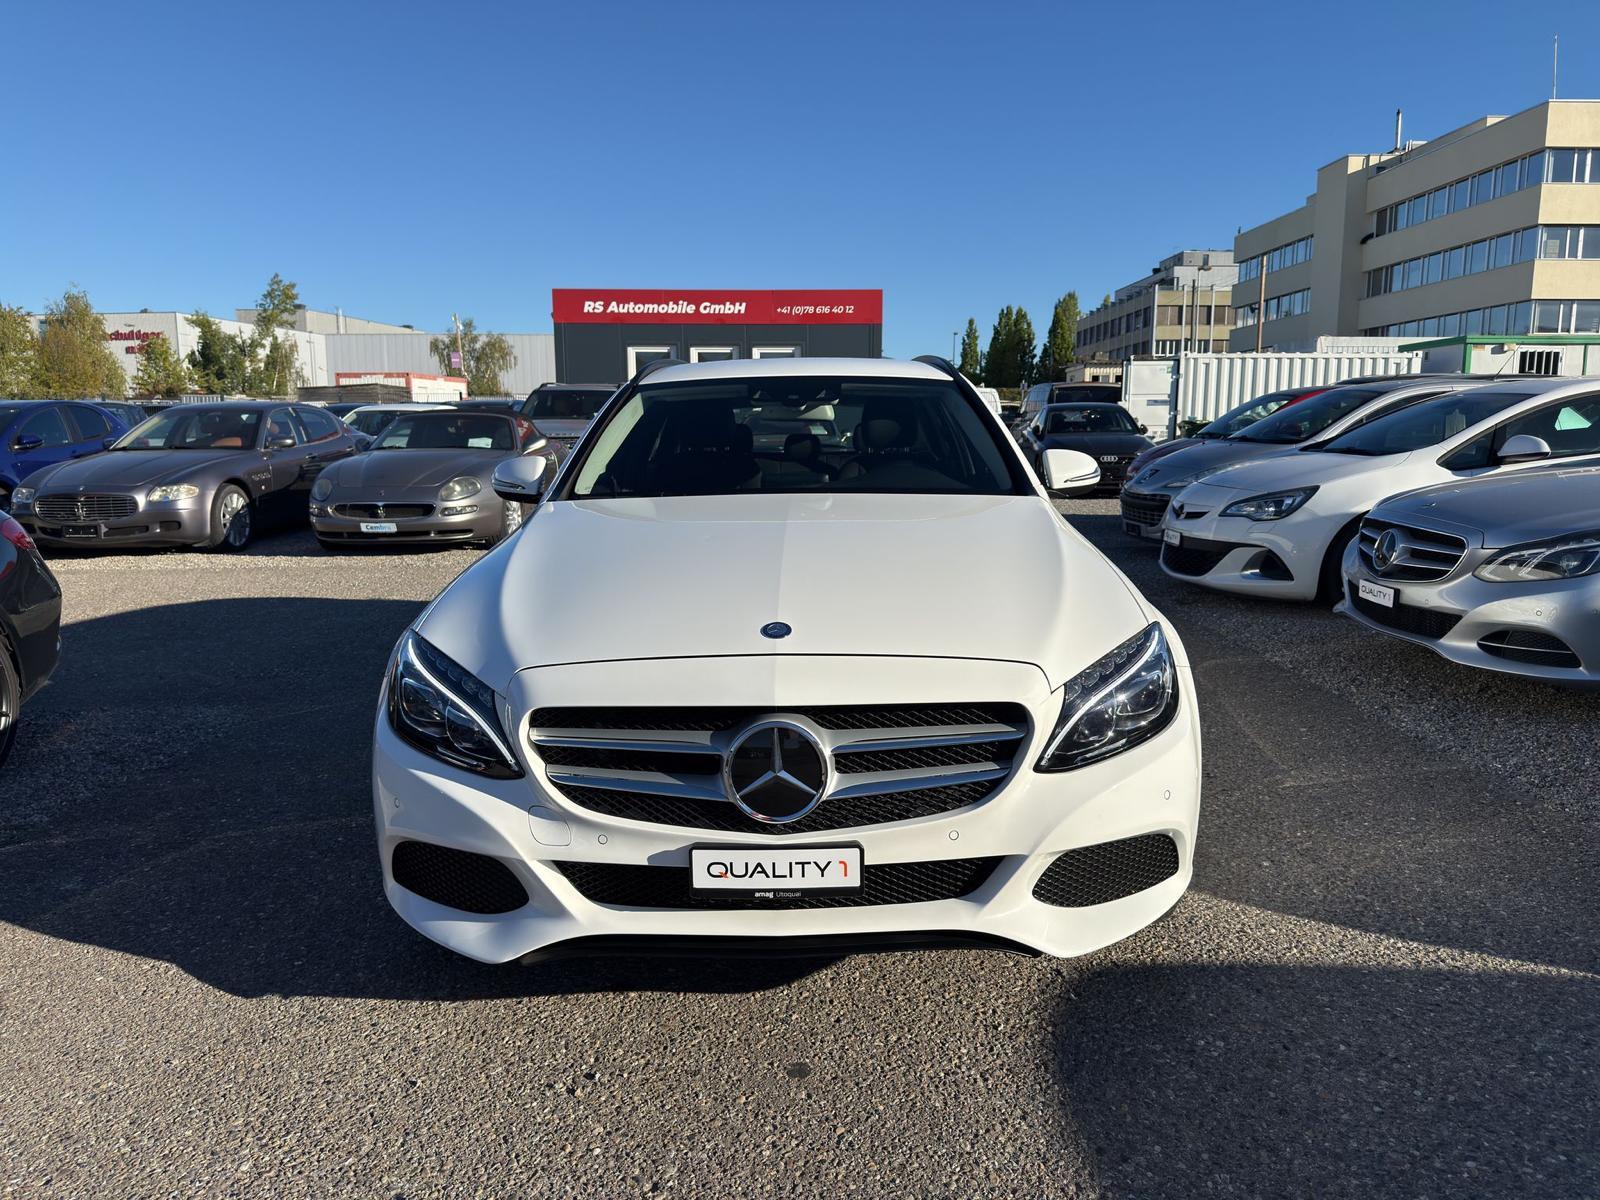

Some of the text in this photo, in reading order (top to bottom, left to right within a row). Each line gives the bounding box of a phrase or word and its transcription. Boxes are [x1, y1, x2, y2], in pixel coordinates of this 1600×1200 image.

[583, 301, 746, 314] RS Automobile GmbH
[777, 305, 854, 315] +41 (0)78 616 40 12
[1361, 585, 1387, 600] QUALITY
[707, 860, 848, 879] QUALITY 1
[754, 891, 774, 899] amag
